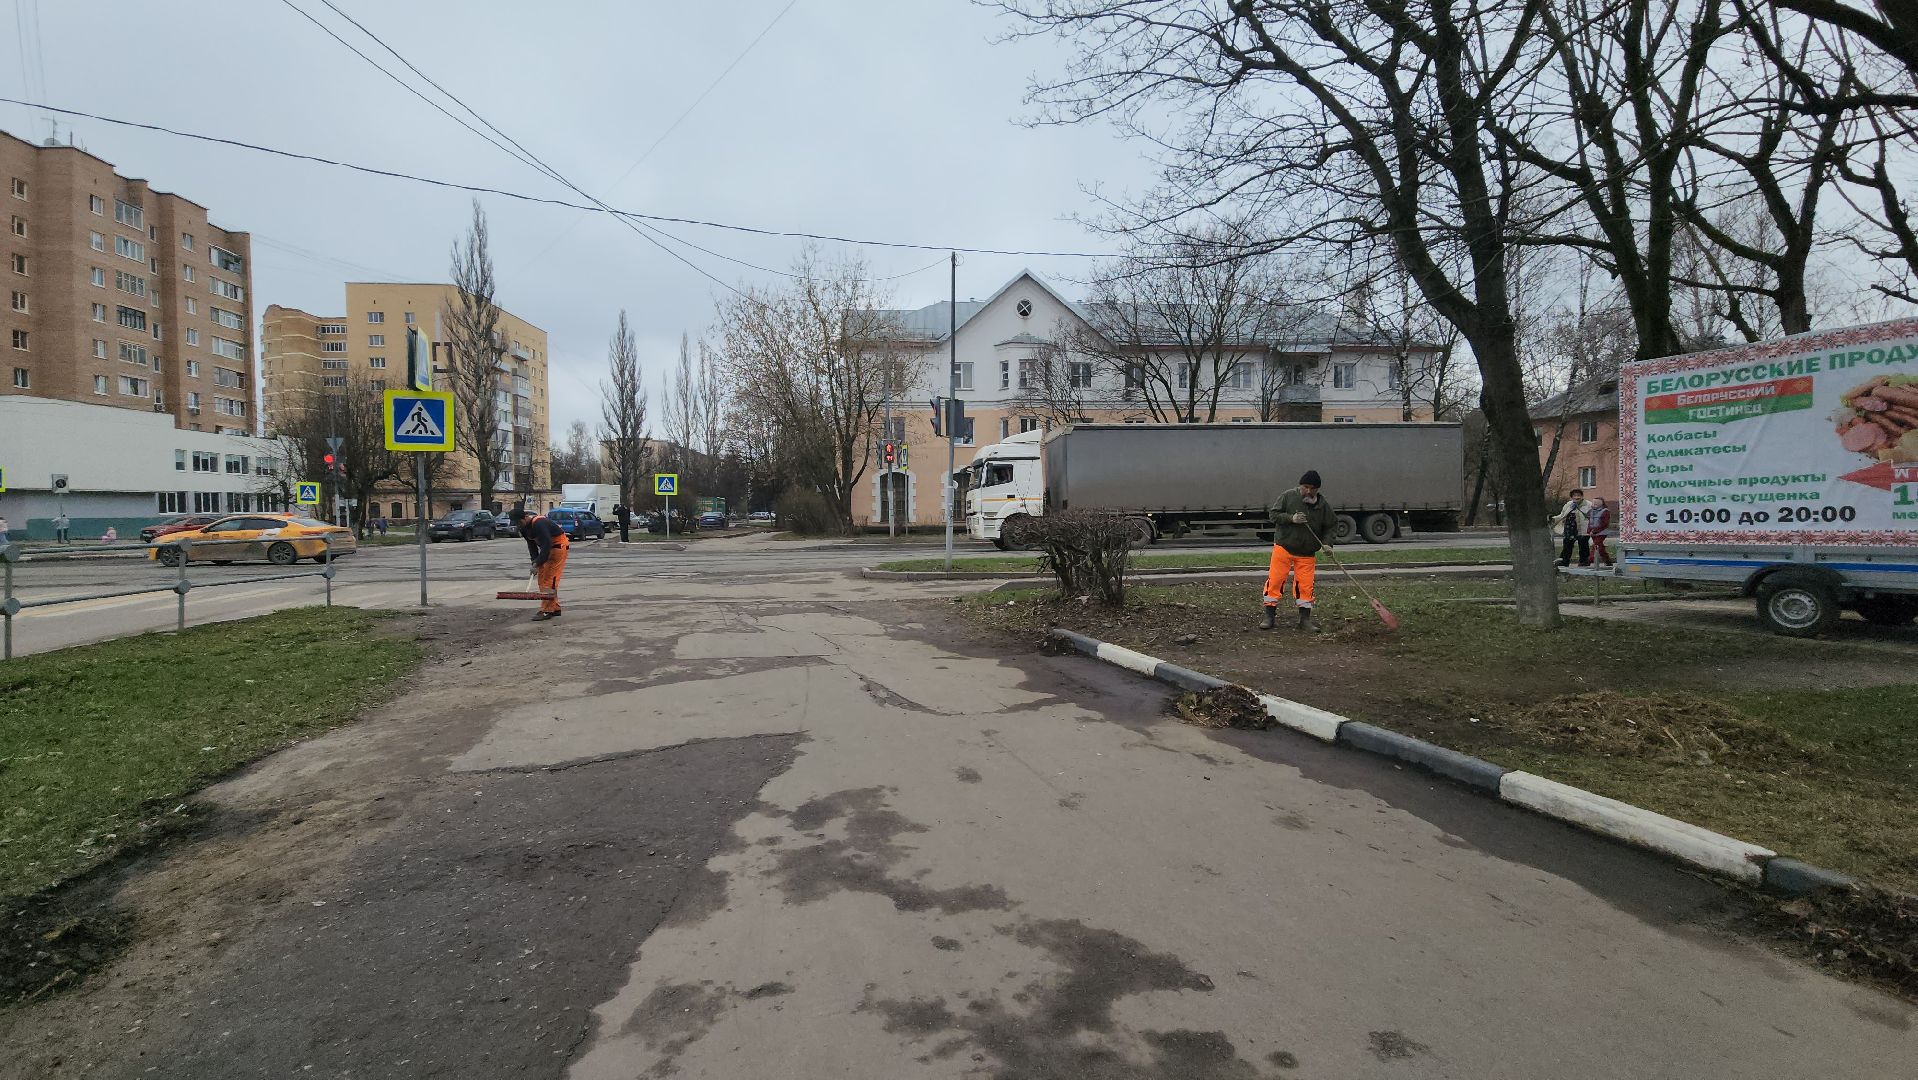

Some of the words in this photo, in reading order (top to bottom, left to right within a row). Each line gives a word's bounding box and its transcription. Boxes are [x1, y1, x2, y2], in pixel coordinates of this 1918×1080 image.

[1647, 357, 1820, 394] БЕЛОРУССКИЕ
[1648, 430, 1717, 443] Колбасы
[1646, 444, 1747, 460] Деликатесы
[1648, 464, 1693, 474] Сыры
[1648, 479, 1732, 489] Молочные
[1738, 473, 1826, 487] продукты
[1648, 494, 1716, 505] Тушенка
[1731, 491, 1820, 504] сгущенка
[1646, 512, 1658, 523] с
[1666, 508, 1731, 523] 10:00
[1738, 511, 1770, 525] до
[1778, 506, 1856, 522] 20:00
